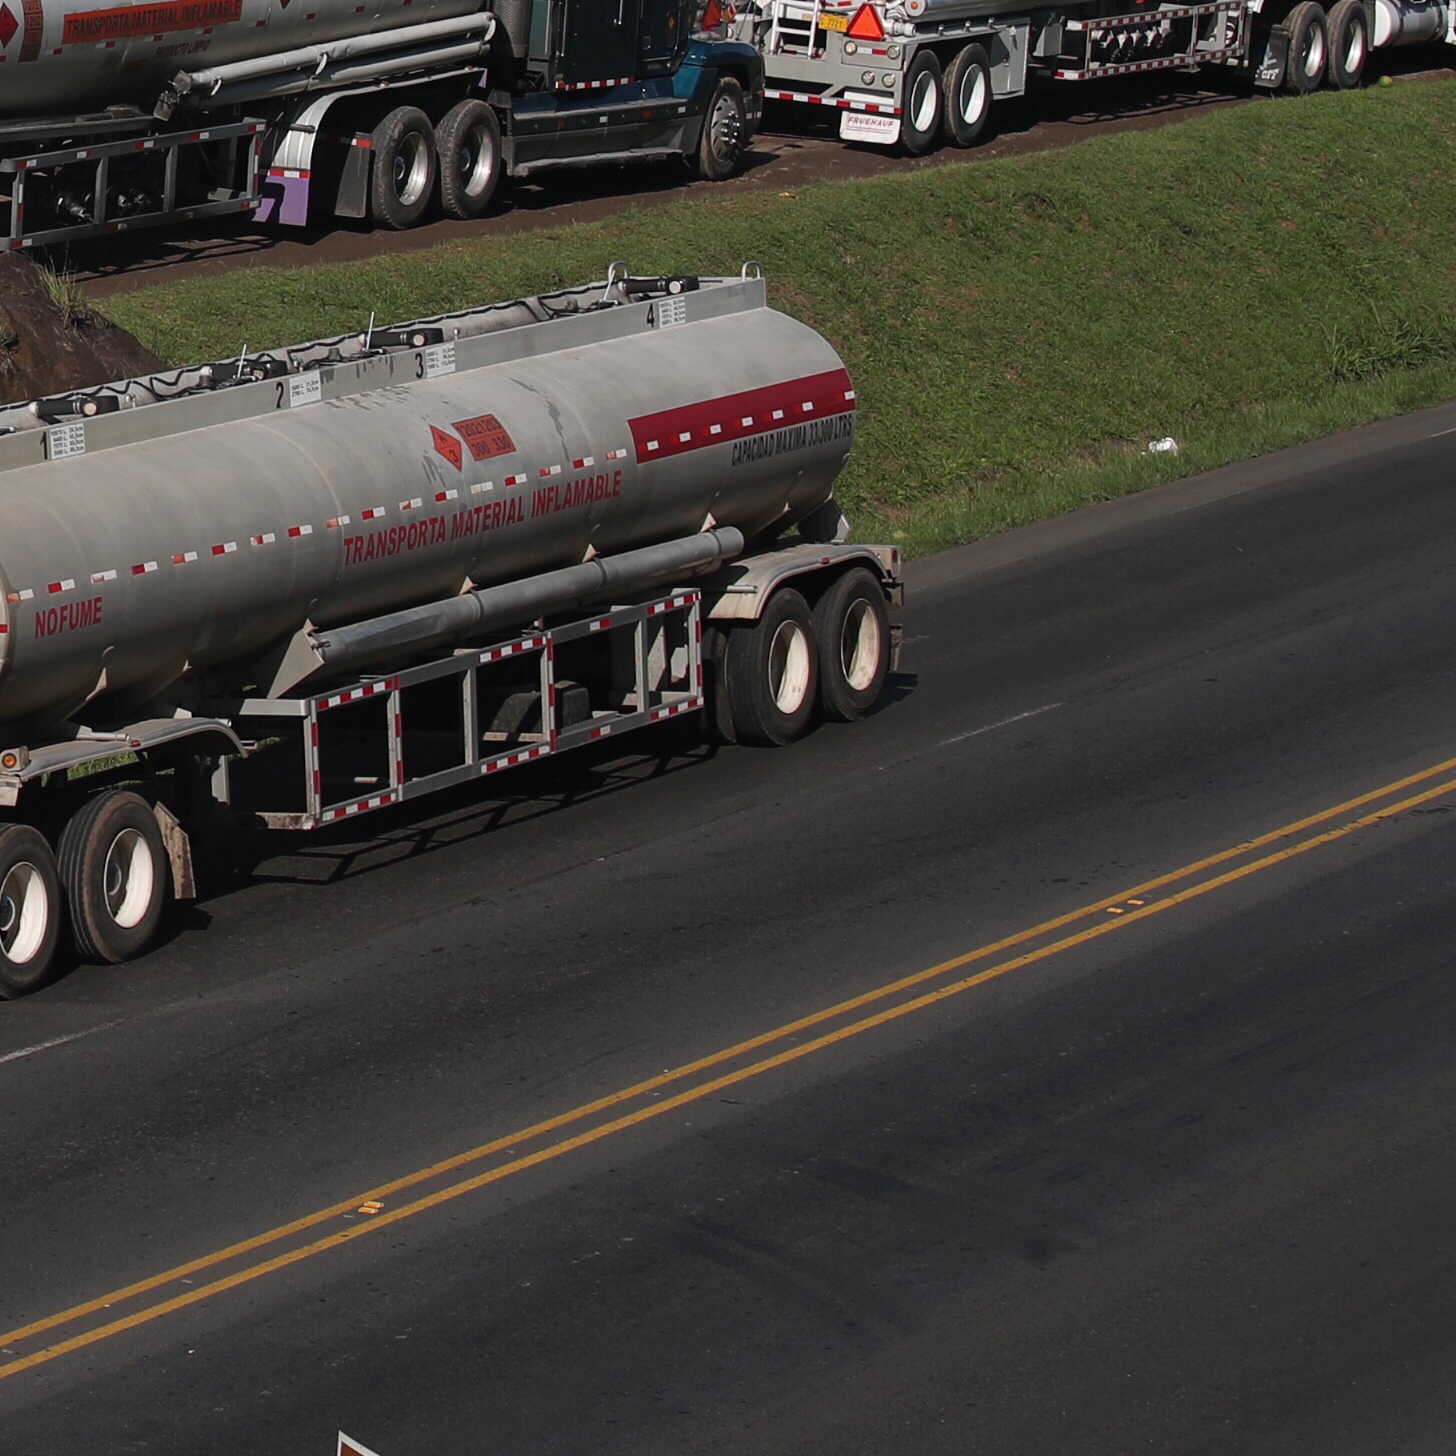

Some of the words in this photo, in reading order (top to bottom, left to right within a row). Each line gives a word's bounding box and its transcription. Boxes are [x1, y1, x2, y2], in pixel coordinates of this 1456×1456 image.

[65, 12, 130, 38] TRANSPORTA
[132, 6, 179, 32] MATERIAL
[847, 116, 894, 128] FRUEHAUF
[646, 302, 655, 328] 4
[414, 352, 424, 379] 3
[39, 431, 48, 461] 1
[471, 440, 491, 457] 300
[491, 435, 511, 452] 330
[731, 433, 775, 467] CAPACIDAD
[775, 424, 807, 456] MAXIMA
[835, 412, 853, 442] LTRS
[448, 449, 460, 463] 3
[343, 515, 446, 566] TRANSPORTA
[450, 495, 525, 541] MATERIAL
[530, 469, 623, 519] INFLAMABLE
